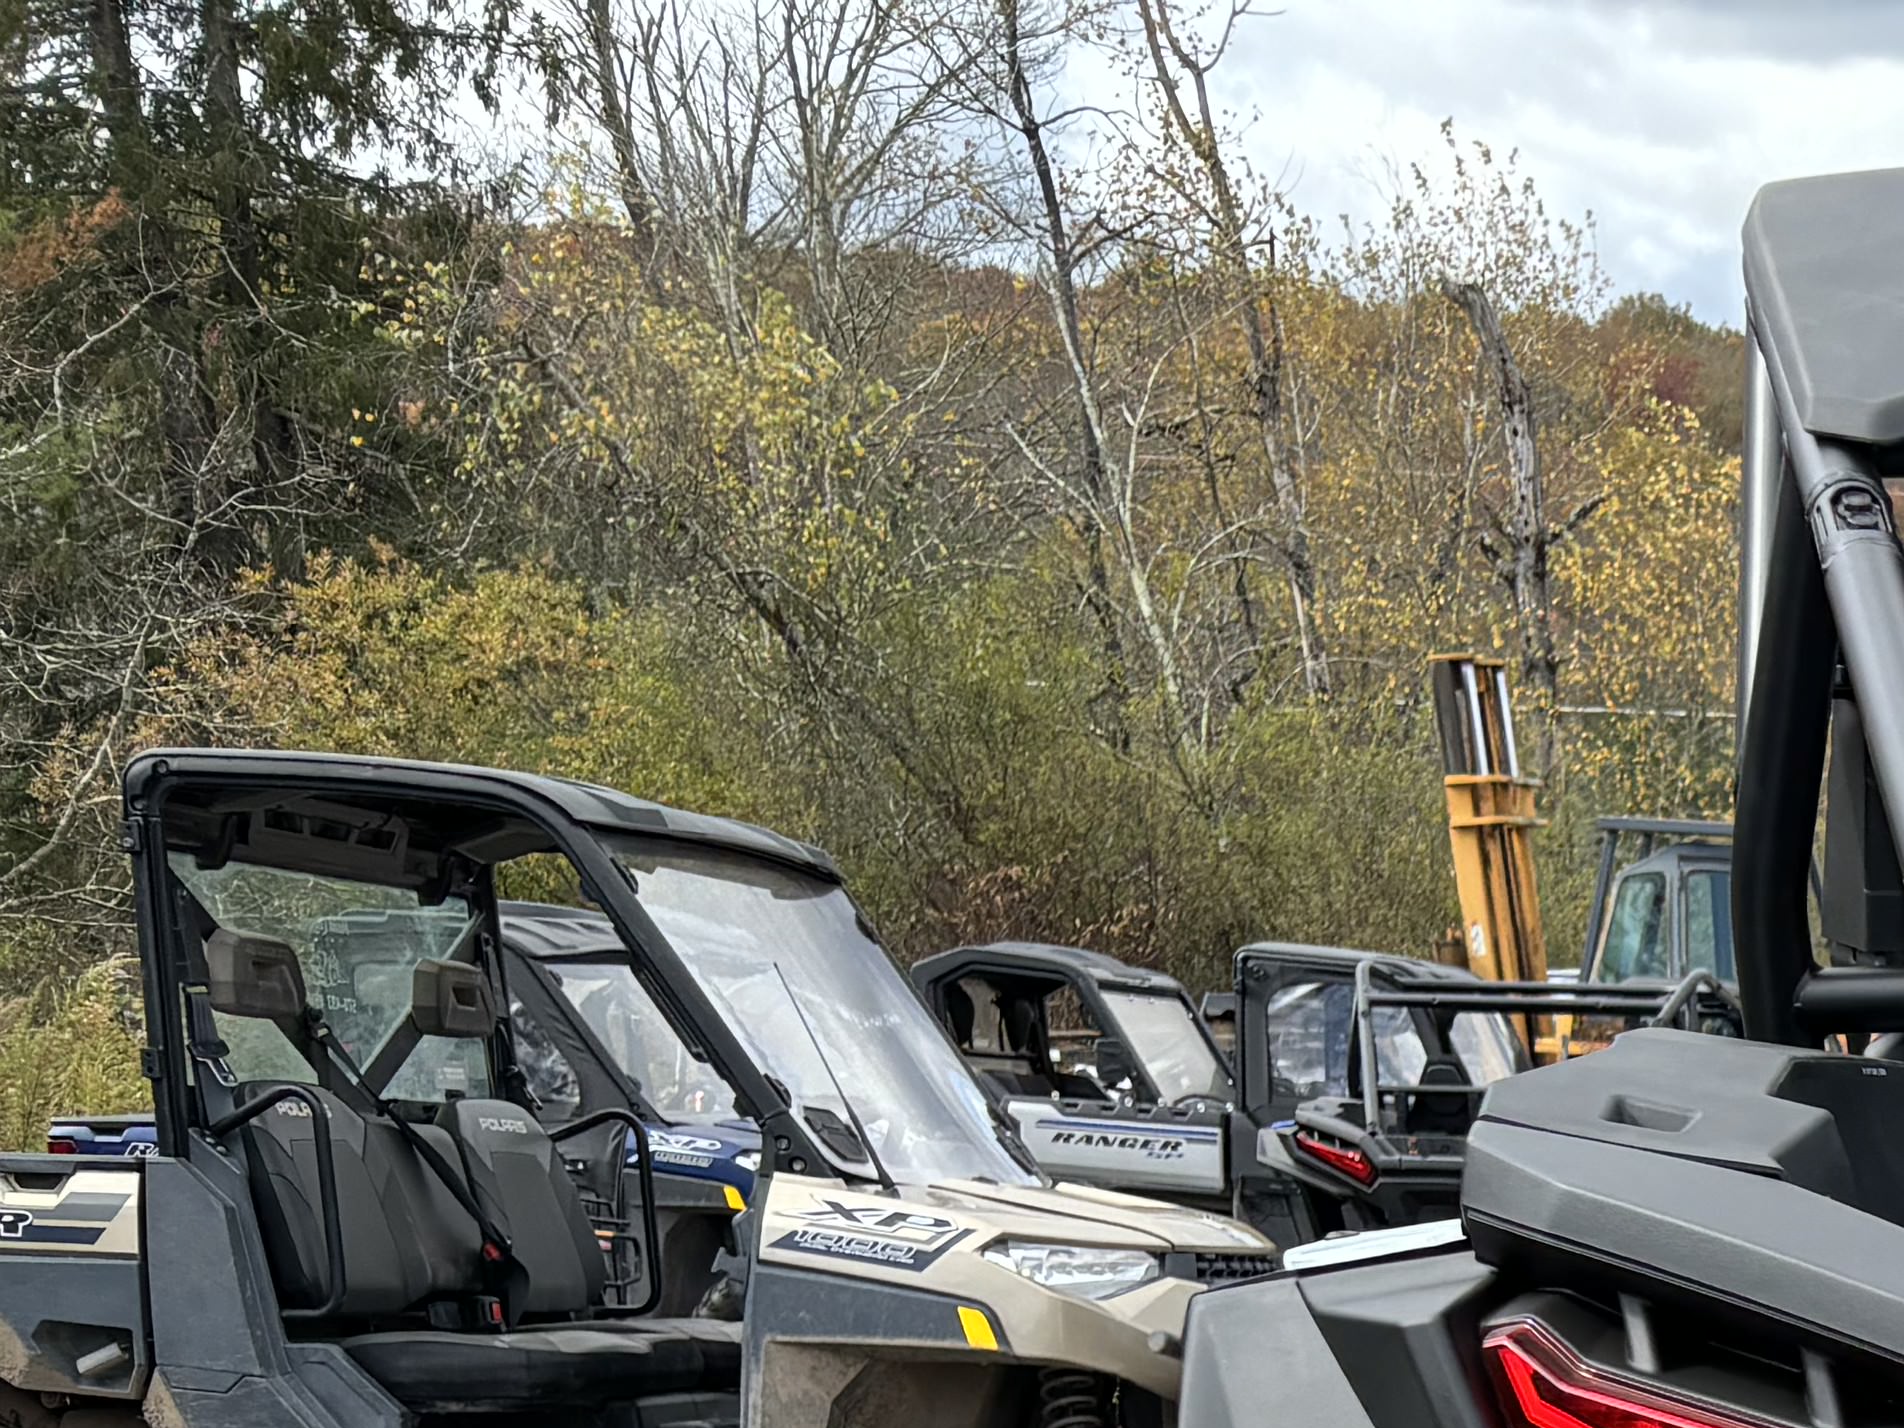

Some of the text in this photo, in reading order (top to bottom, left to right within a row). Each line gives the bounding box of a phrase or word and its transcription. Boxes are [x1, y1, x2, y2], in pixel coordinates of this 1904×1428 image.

[478, 1117, 528, 1134] POLARIS
[1051, 1132, 1184, 1151] RANGER
[793, 1198, 958, 1233] XP
[793, 1229, 918, 1260] 1000
